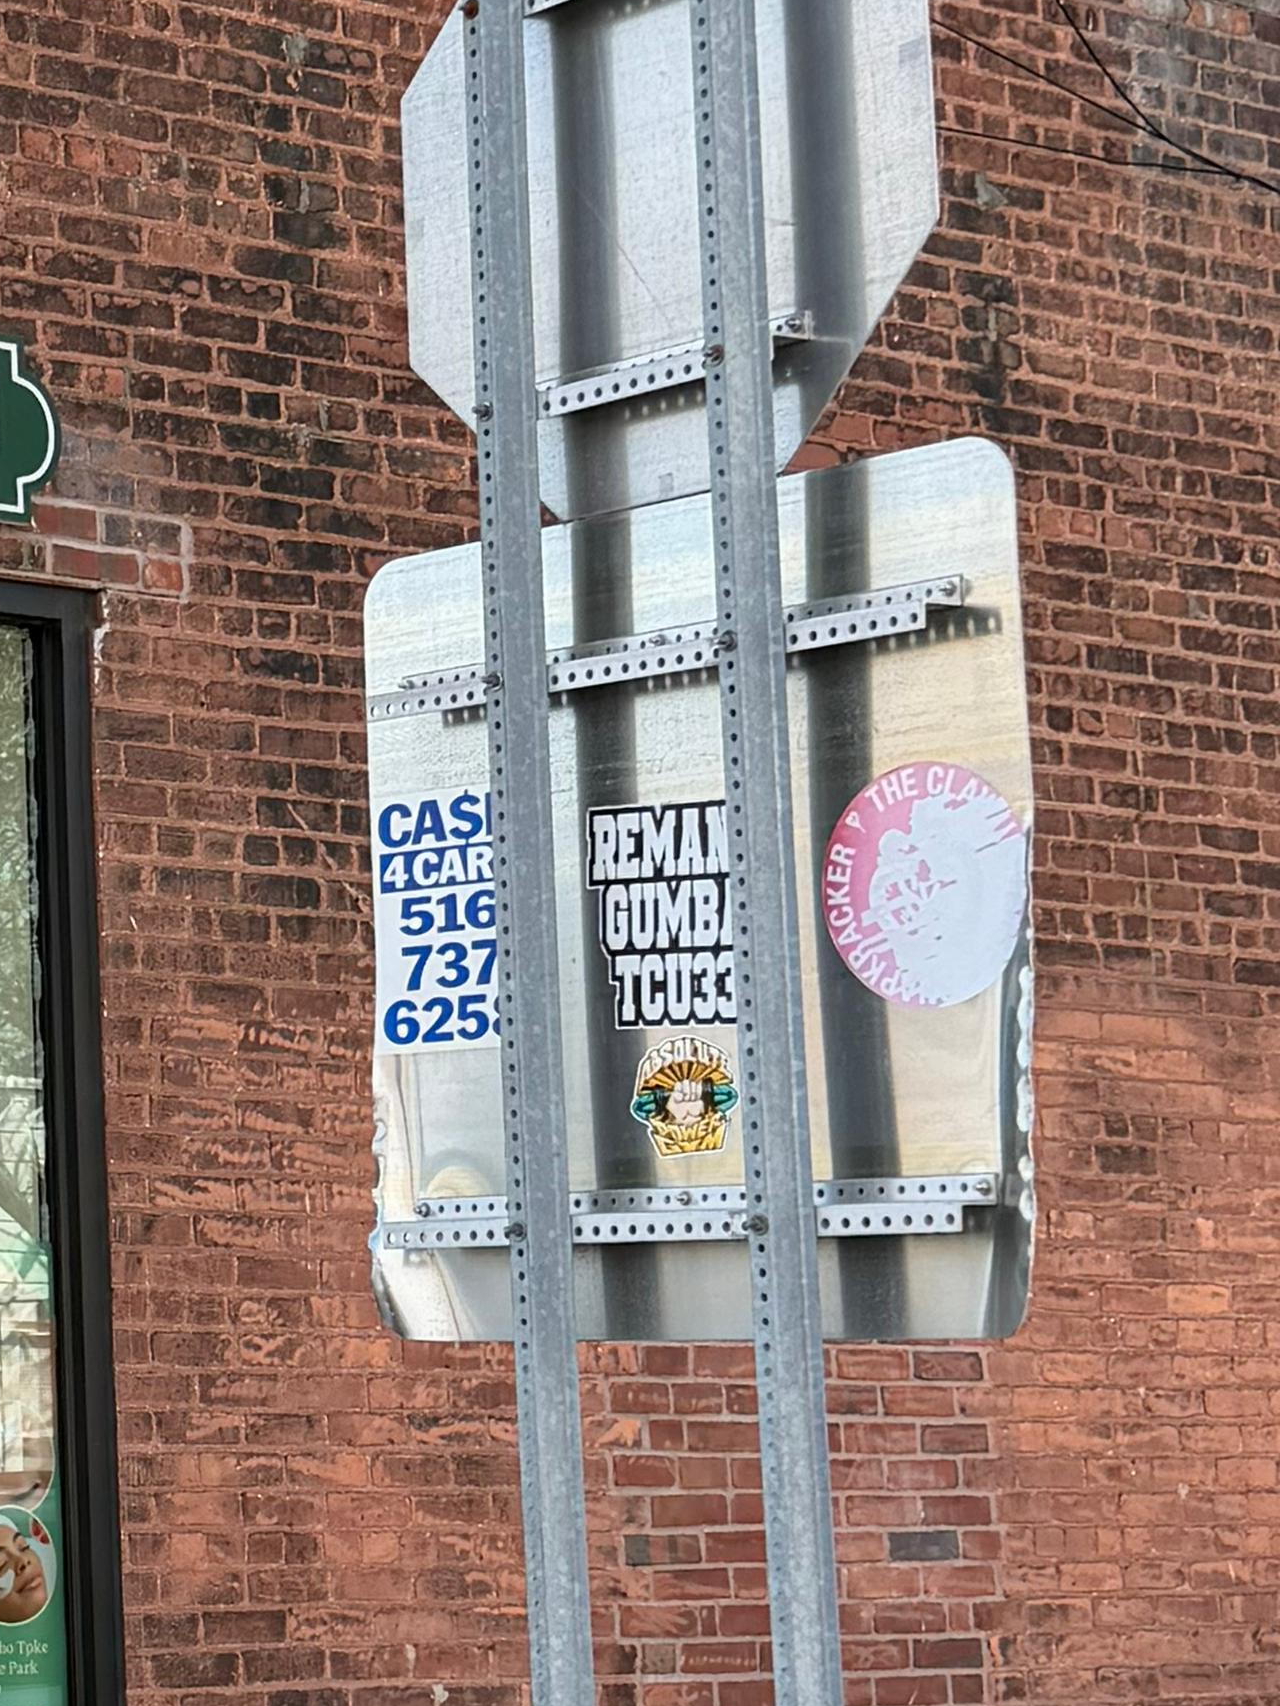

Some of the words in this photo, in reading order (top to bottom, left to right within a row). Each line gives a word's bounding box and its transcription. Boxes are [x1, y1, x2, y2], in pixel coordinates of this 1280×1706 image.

[864, 768, 919, 813] THE
[399, 890, 495, 936] 516
[9, 1660, 38, 1675] Park
